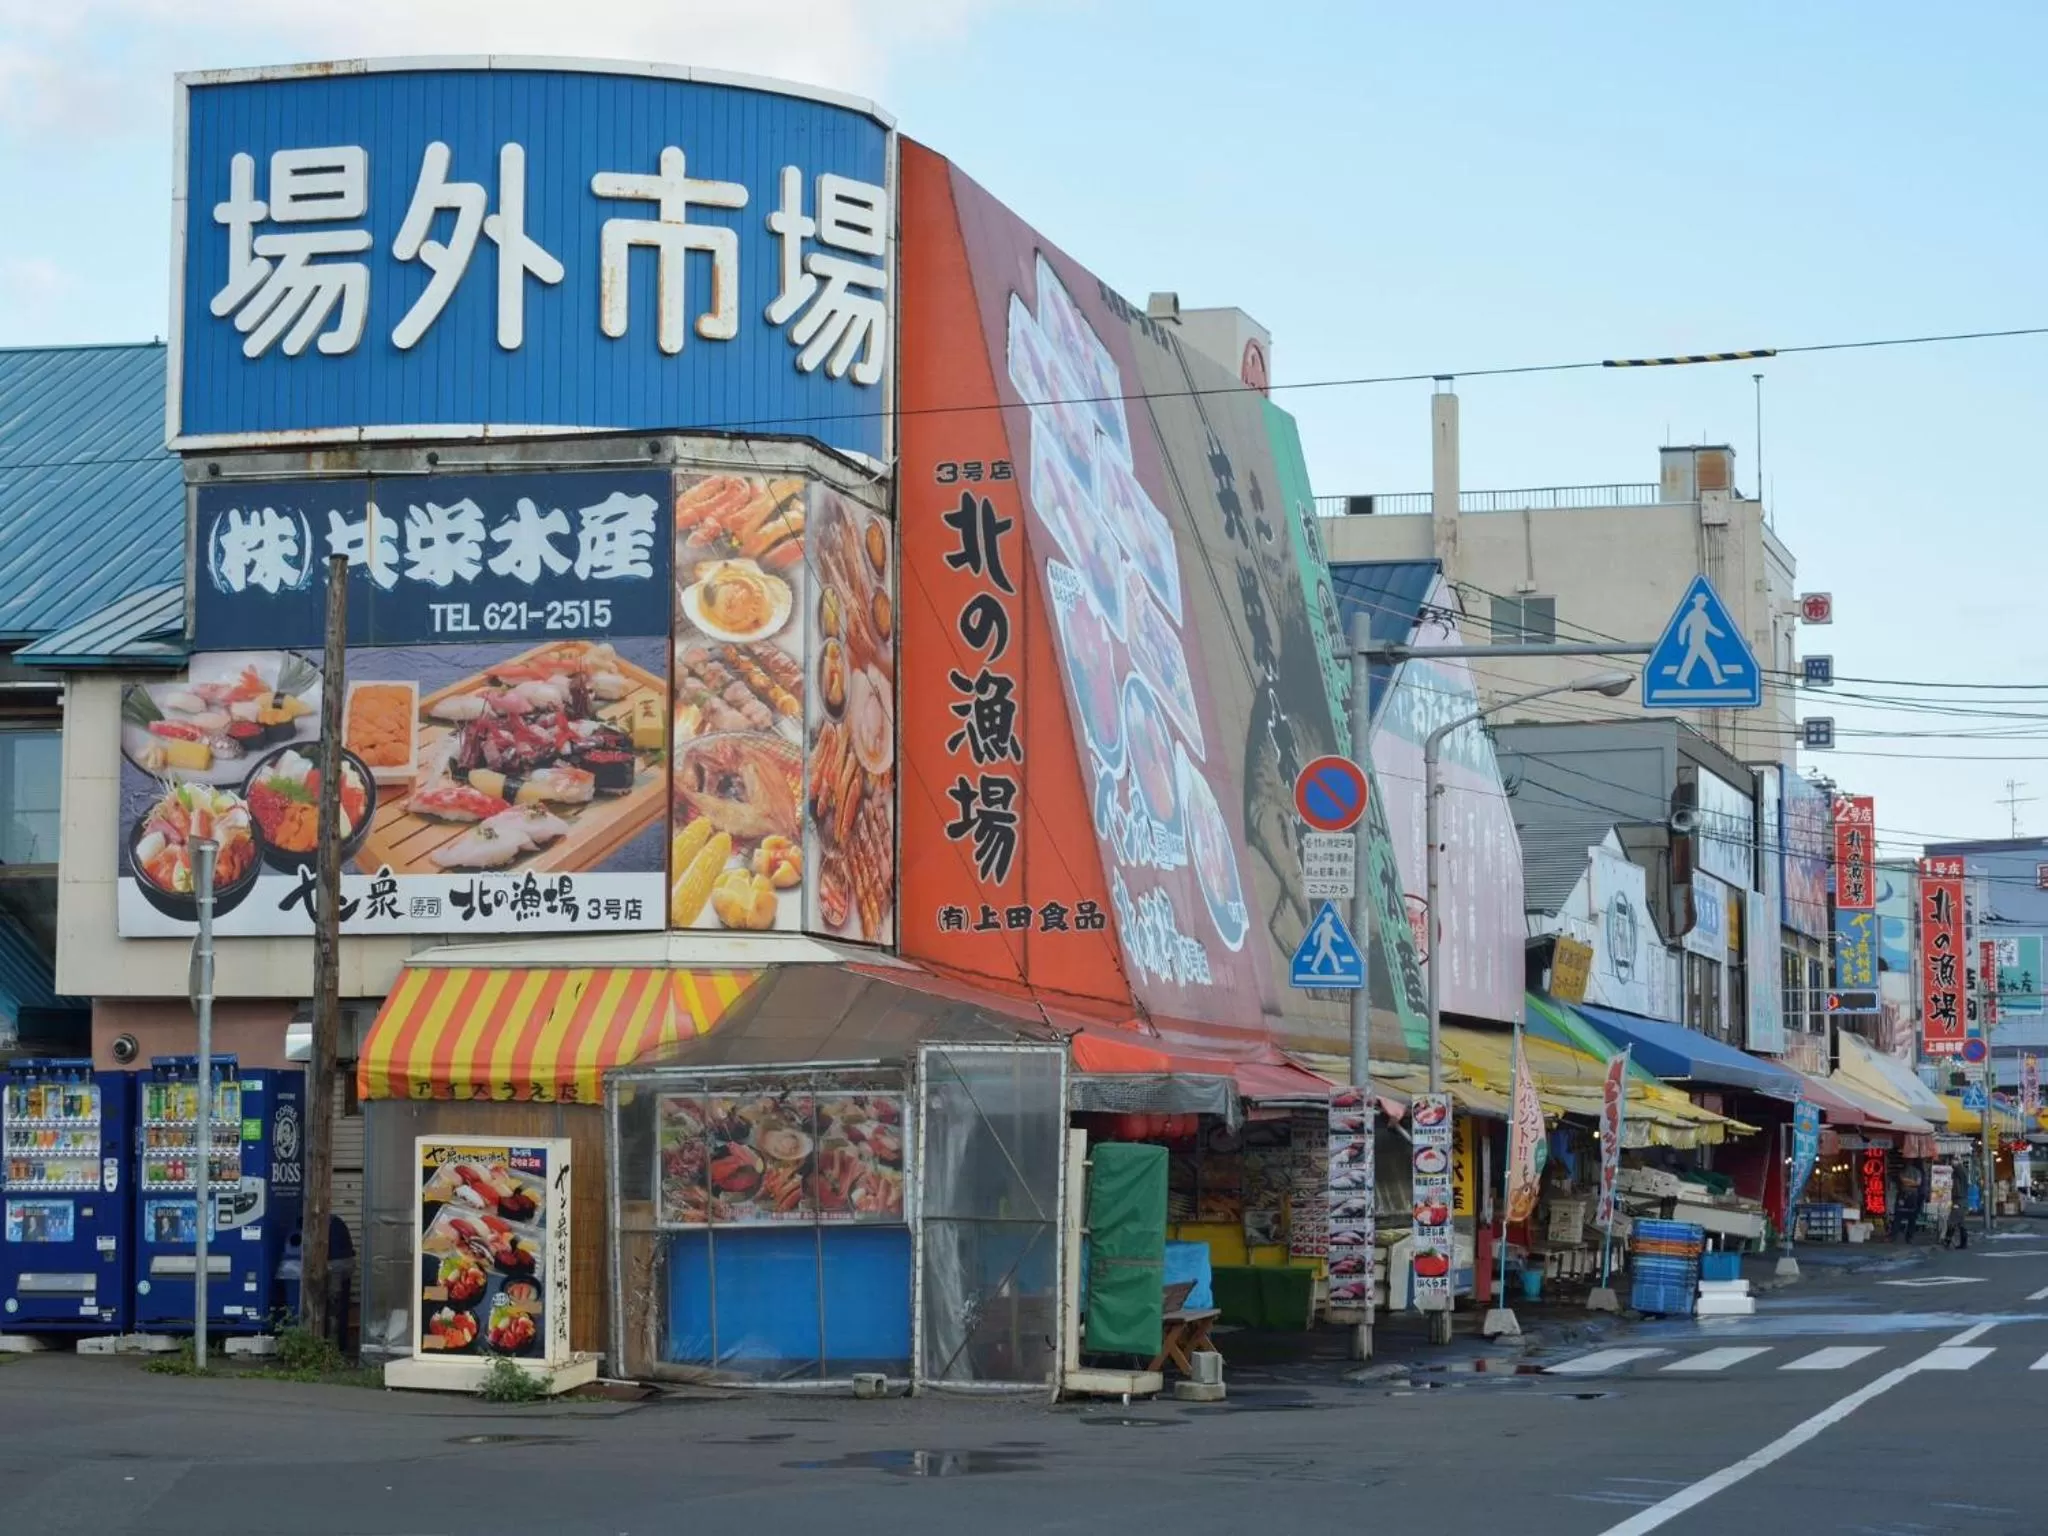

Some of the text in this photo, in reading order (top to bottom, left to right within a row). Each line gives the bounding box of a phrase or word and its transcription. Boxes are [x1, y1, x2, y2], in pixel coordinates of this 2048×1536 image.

[209, 141, 888, 385] 場外市場
[935, 460, 1015, 483] 3号店
[429, 600, 612, 632] TEL 621-2515
[942, 490, 1022, 887] 北の漁場
[449, 871, 580, 922] 北の漁場
[588, 898, 642, 920] 3号店
[1309, 883, 1348, 893] ここから
[937, 901, 1107, 933] (有)上田食品
[1928, 886, 1958, 1034] 北の漁場
[415, 1081, 579, 1102] アイスうえだ
[272, 1163, 301, 1183] BOSS
